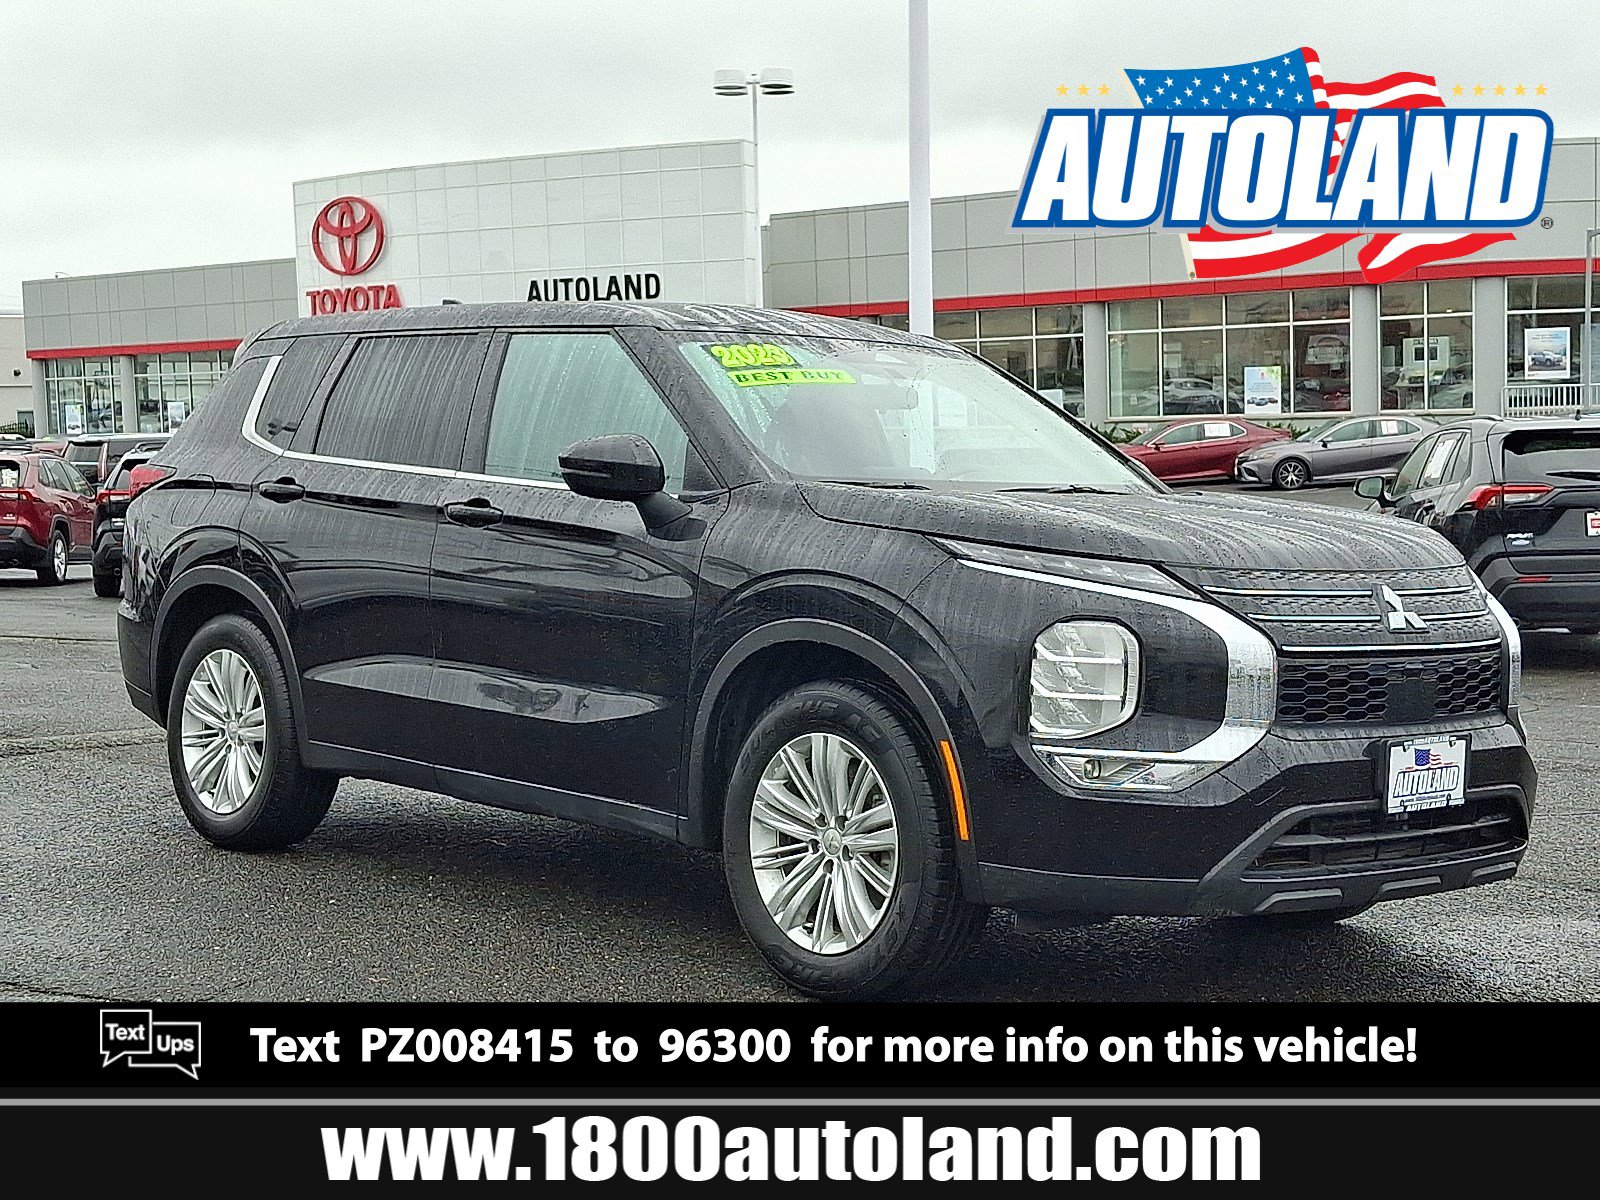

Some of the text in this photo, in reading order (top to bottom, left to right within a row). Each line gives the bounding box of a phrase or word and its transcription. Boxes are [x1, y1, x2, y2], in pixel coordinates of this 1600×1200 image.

[306, 284, 401, 315] TOYOTA
[527, 273, 661, 302] AUTOLAND
[734, 370, 845, 384] BEST BUY
[1393, 766, 1459, 798] AUTOLAND
